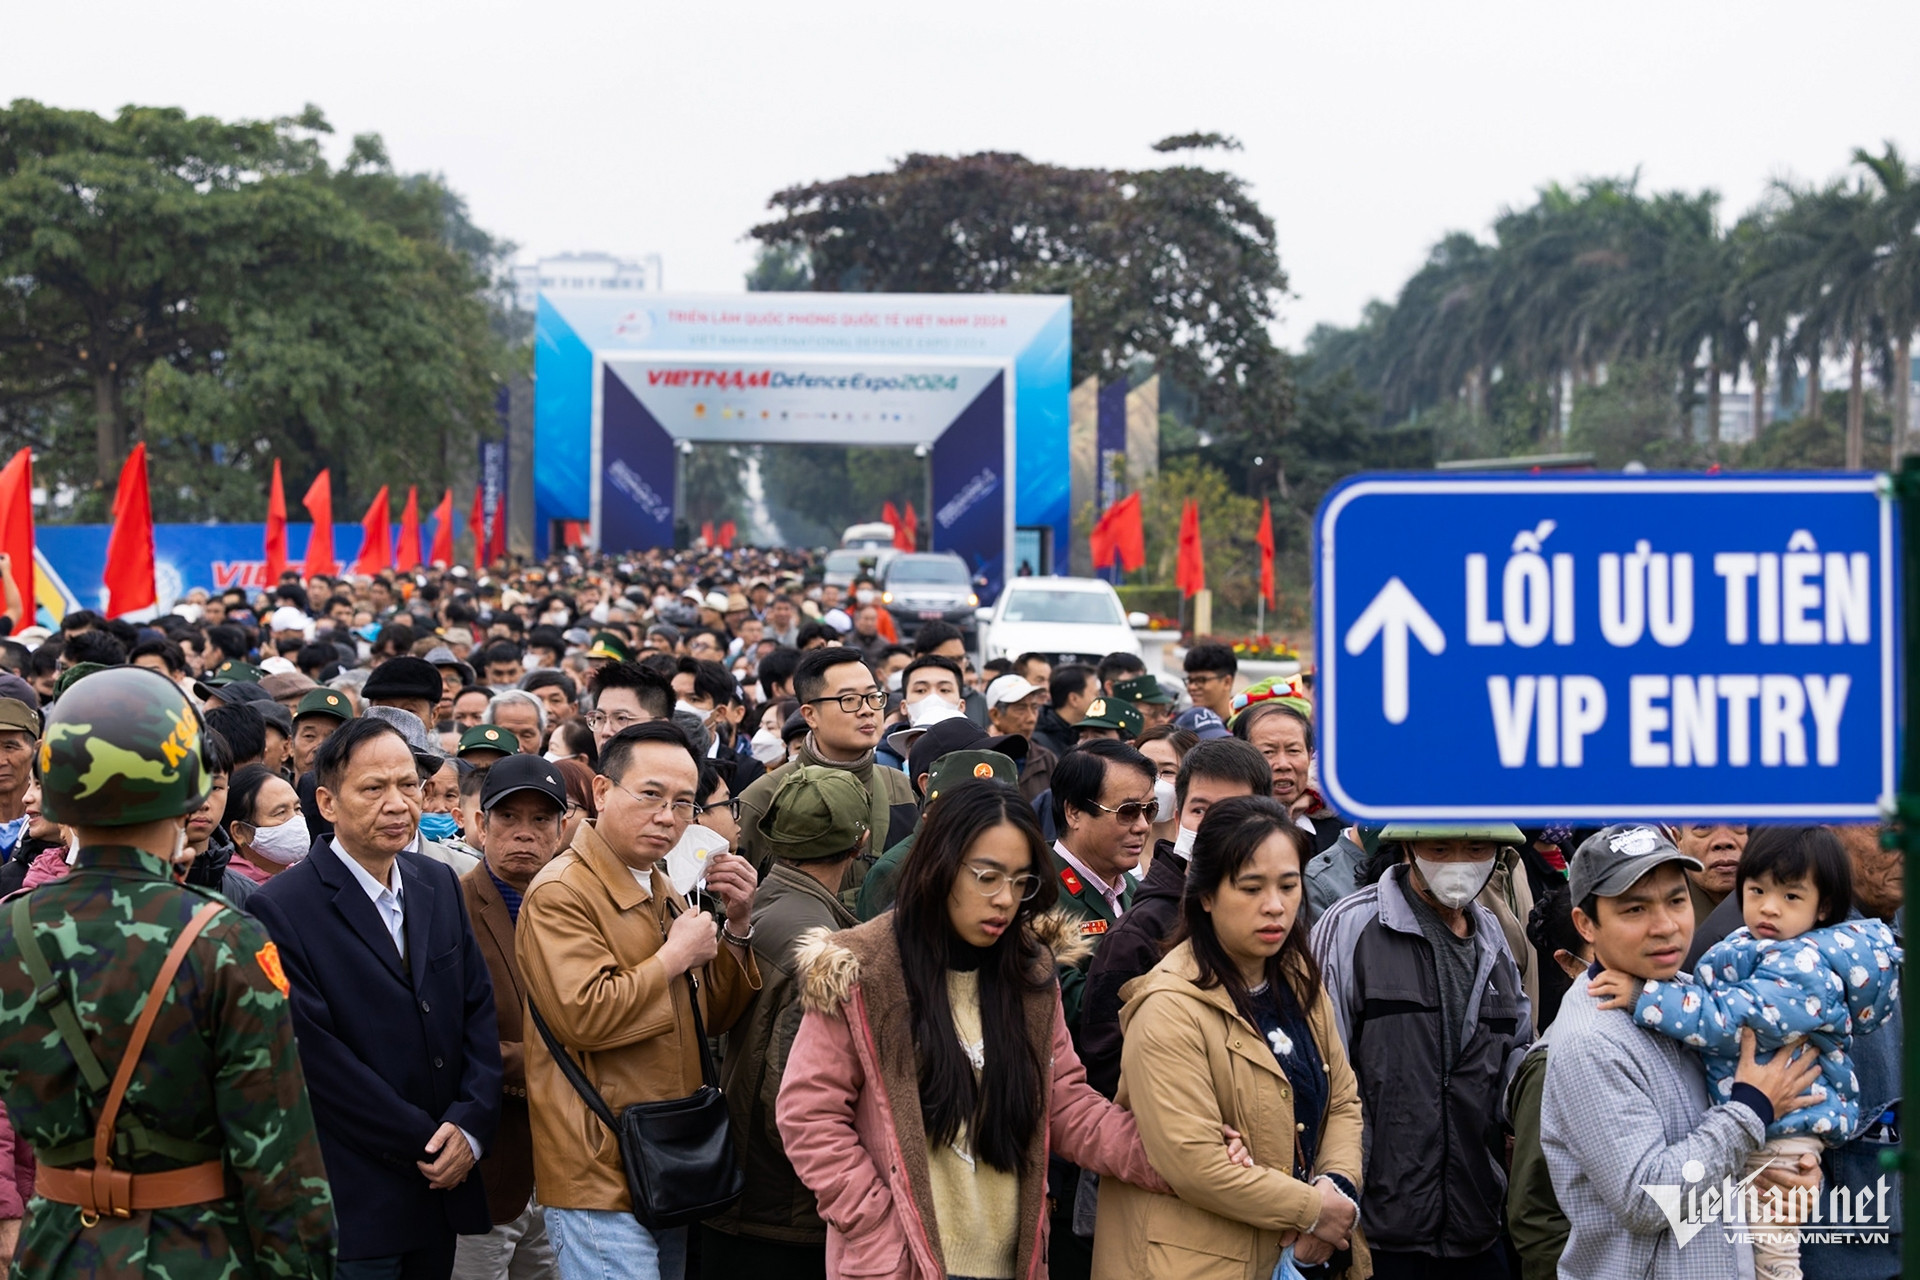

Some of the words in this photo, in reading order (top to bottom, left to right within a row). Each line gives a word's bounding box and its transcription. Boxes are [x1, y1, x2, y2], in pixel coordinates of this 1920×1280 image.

[1466, 519, 1575, 648] LỐI
[1599, 538, 1694, 648] ƯU
[1714, 529, 1870, 646] TIÊN
[1487, 674, 1608, 768] VIP
[1629, 673, 1852, 768] ENTRY
